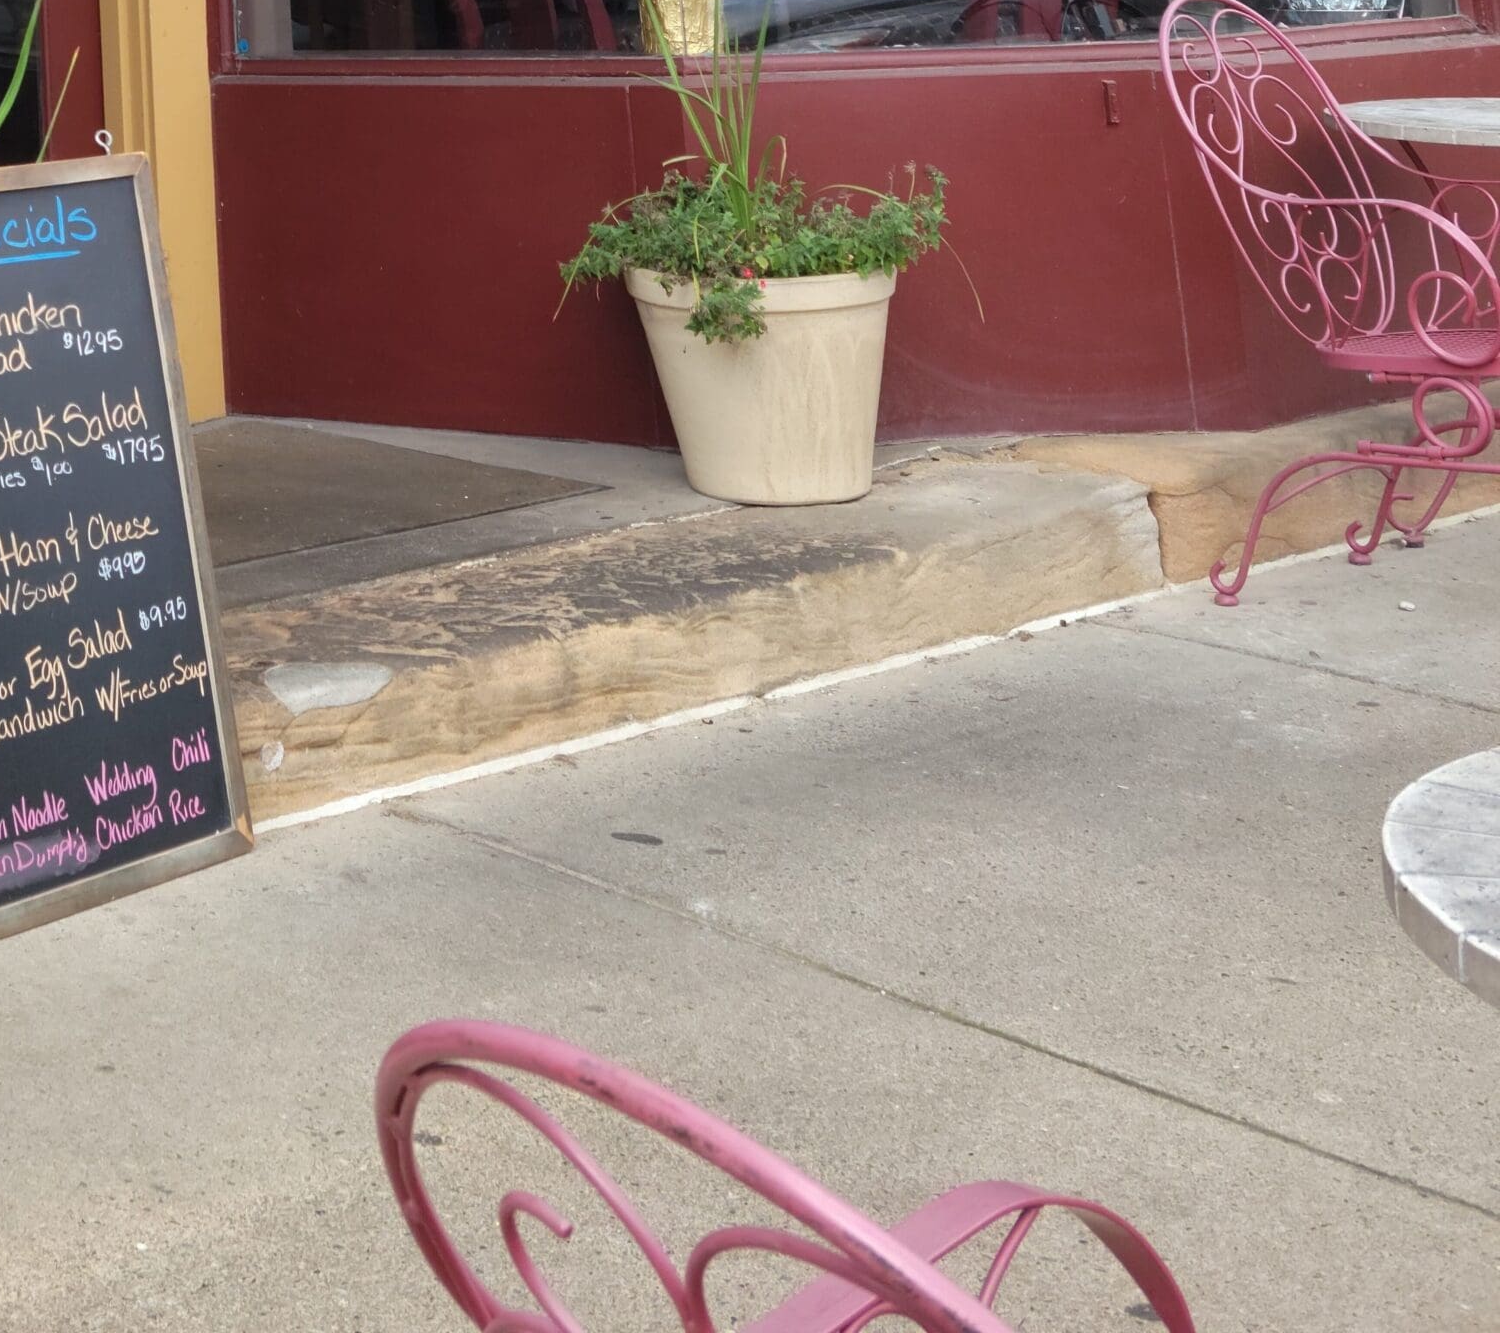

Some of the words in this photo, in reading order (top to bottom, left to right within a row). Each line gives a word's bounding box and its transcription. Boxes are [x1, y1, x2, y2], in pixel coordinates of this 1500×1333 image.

[62, 386, 148, 447] Salad
[65, 511, 80, 563] &
[87, 513, 159, 550] Cheese
[25, 645, 66, 700] Egg
[67, 607, 133, 670] Salad
[138, 595, 187, 631] $9.95
[159, 672, 175, 693] or
[172, 654, 207, 697] Soup
[12, 791, 69, 836] Noodle
[84, 759, 157, 810] Wedding
[172, 726, 210, 771] Chili
[96, 805, 163, 850] Chicken
[169, 789, 206, 826] Rice
